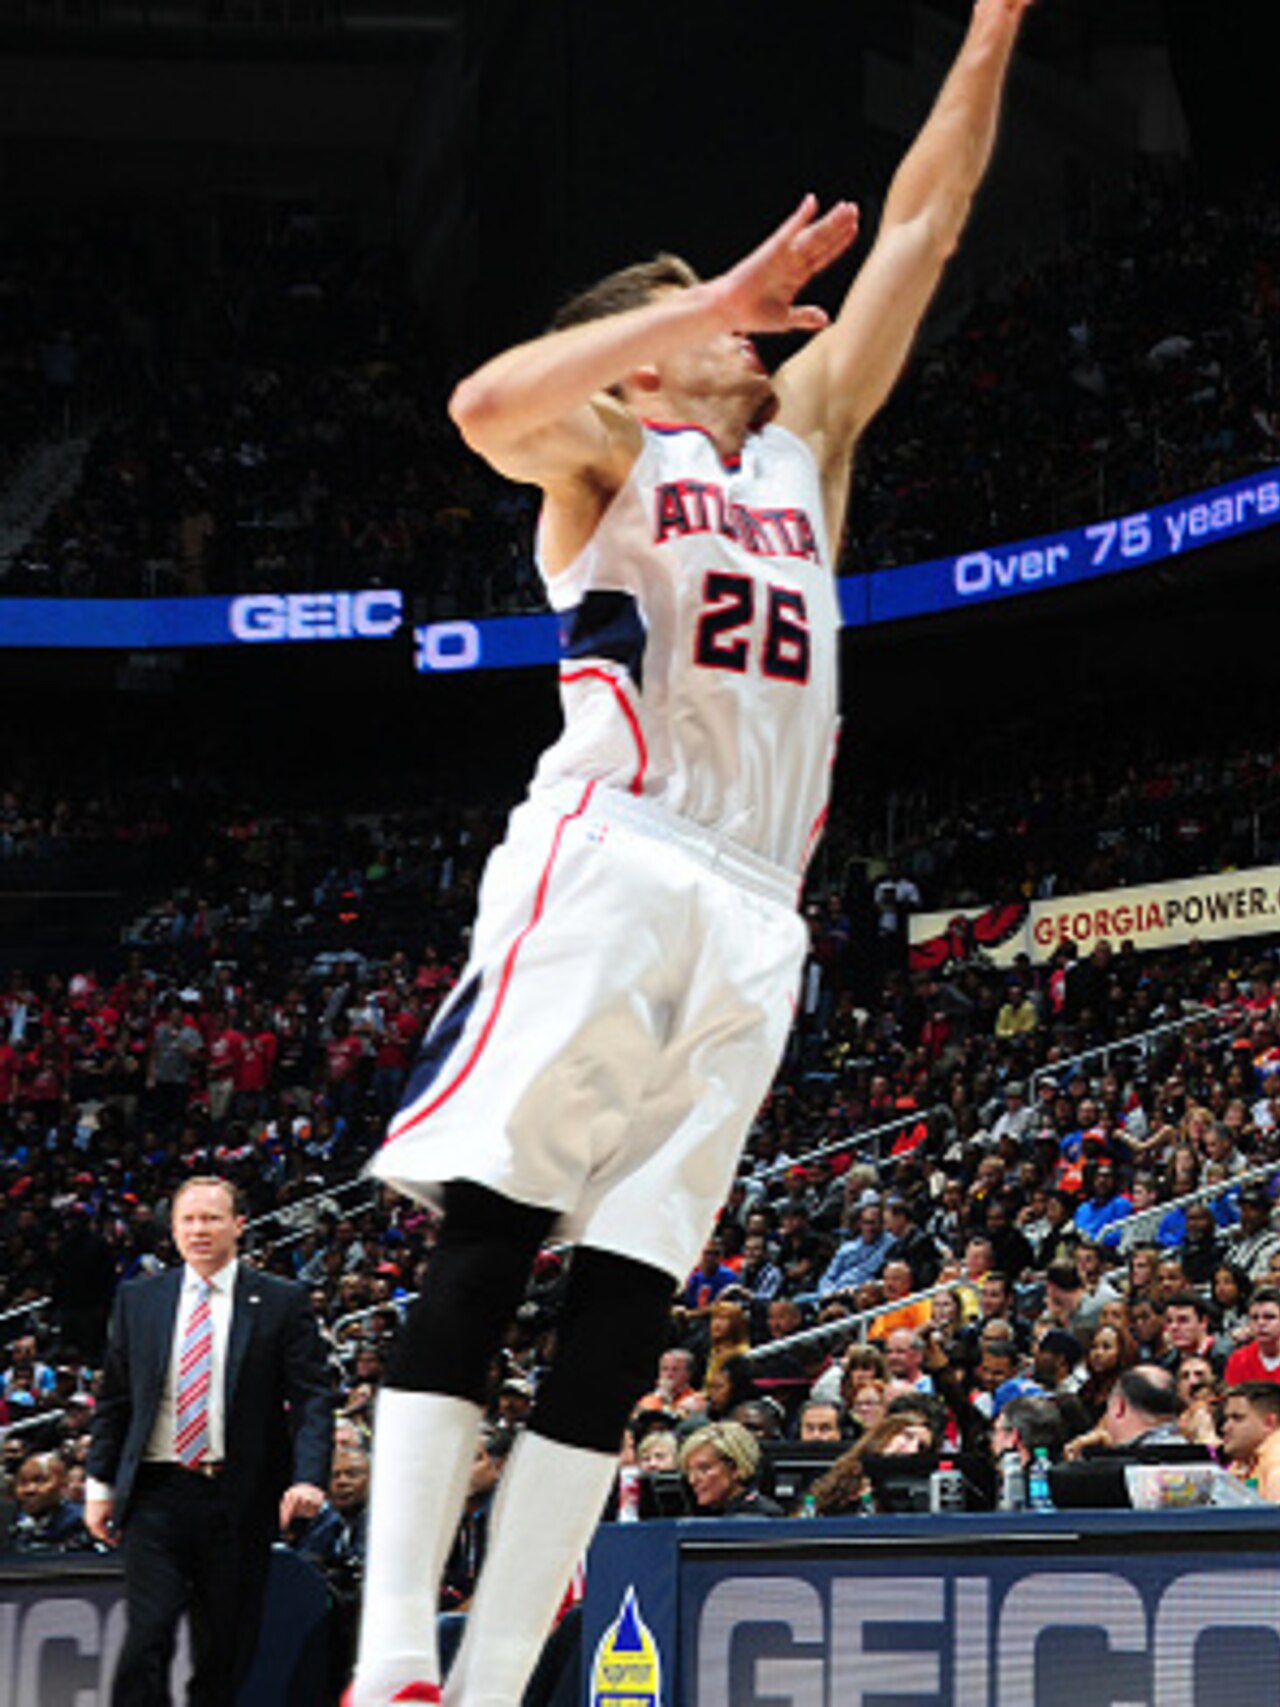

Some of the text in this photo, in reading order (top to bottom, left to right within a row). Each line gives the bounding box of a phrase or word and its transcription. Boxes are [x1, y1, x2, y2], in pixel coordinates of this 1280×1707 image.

[955, 543, 1070, 595] Over
[1085, 512, 1152, 566] 75
[1165, 480, 1280, 554] years
[230, 589, 403, 643] GEIC
[414, 620, 480, 671] O
[694, 569, 811, 687] 26
